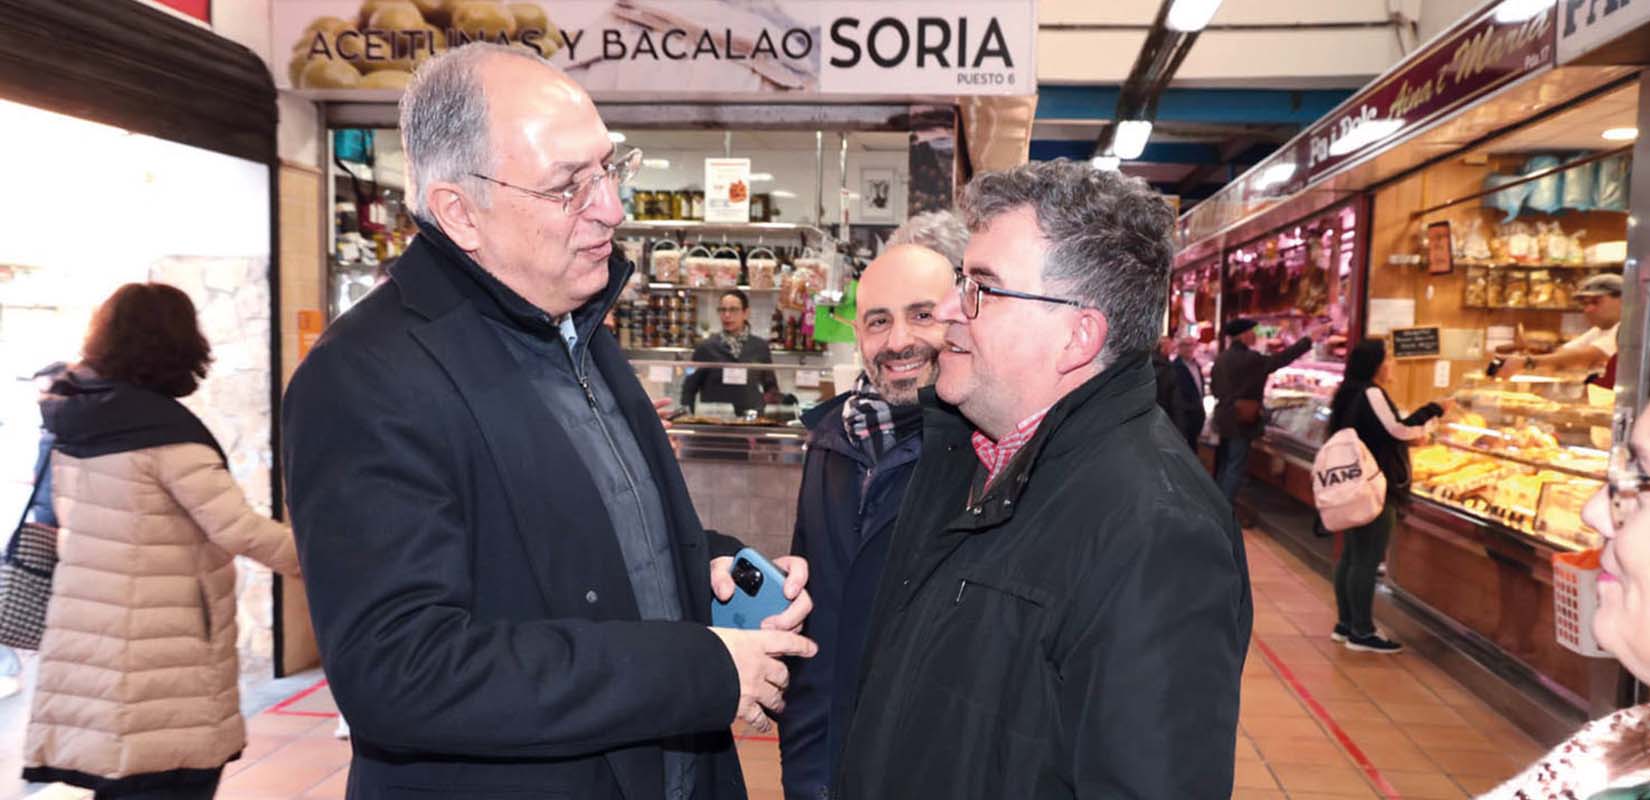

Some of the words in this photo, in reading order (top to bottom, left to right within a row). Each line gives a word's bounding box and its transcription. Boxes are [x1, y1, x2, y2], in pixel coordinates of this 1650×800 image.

[560, 29, 584, 60] Y
[603, 28, 813, 60] BACALAO
[829, 17, 1014, 69] SORIA
[957, 72, 1005, 85] PUESTO
[1007, 72, 1016, 85] 6
